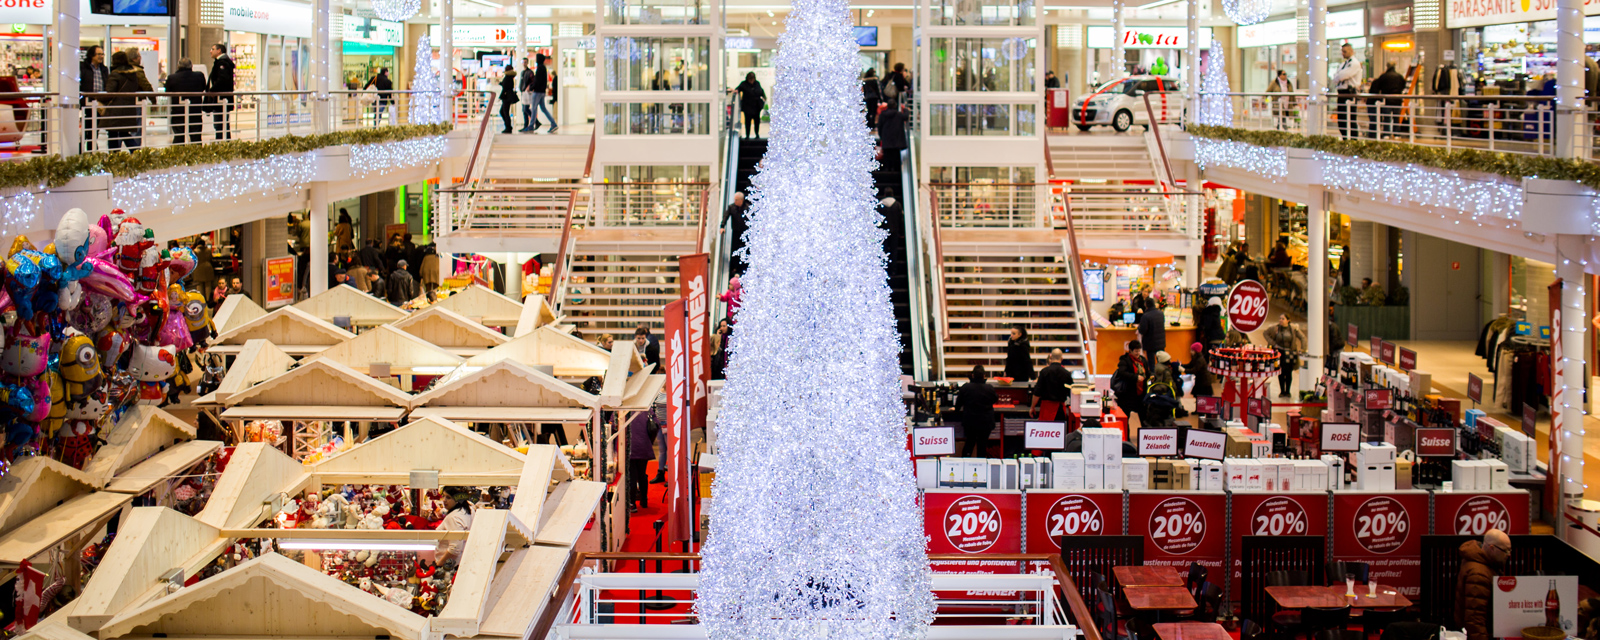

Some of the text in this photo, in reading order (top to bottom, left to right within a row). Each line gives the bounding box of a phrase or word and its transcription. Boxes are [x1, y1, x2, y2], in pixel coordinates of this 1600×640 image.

[229, 7, 270, 20] mobilezone
[1453, 0, 1516, 19] PARASANTE
[1123, 30, 1179, 46] Bta
[1230, 294, 1266, 318] 20%
[688, 275, 706, 406] DENNER
[919, 436, 948, 446] Suisse
[1030, 428, 1060, 438] France
[1330, 433, 1352, 442] ROSÉ
[1421, 437, 1450, 447] Suisse
[1190, 440, 1221, 450] Australie
[948, 510, 998, 536] 20%
[1051, 510, 1100, 536] 20%
[1153, 512, 1202, 538] 20%
[1256, 511, 1304, 535] 20%
[1358, 511, 1406, 538] 20%
[1459, 510, 1507, 535] 20%
[1509, 600, 1520, 608] share
[1524, 600, 1533, 608] kiss
[1534, 600, 1543, 608] with
